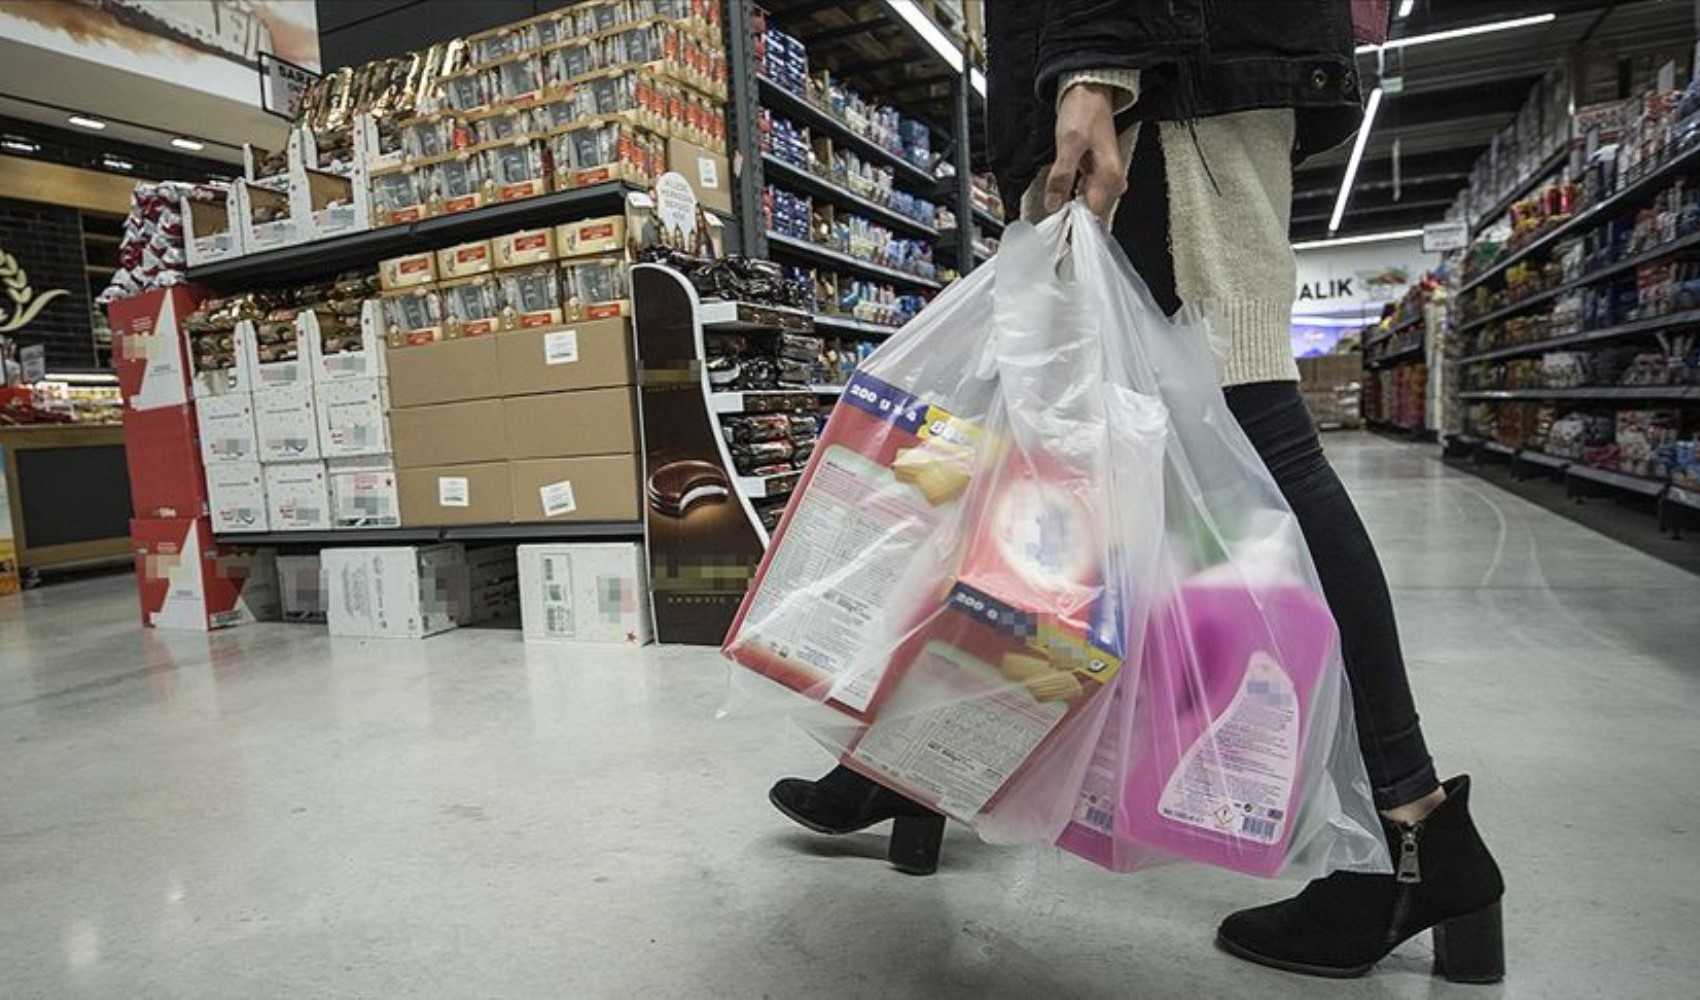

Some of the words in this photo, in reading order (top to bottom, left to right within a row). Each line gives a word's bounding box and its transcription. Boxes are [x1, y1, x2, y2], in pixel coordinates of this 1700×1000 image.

[1299, 278, 1353, 300] ALIK
[850, 384, 877, 403] 200
[955, 592, 984, 611] 200
